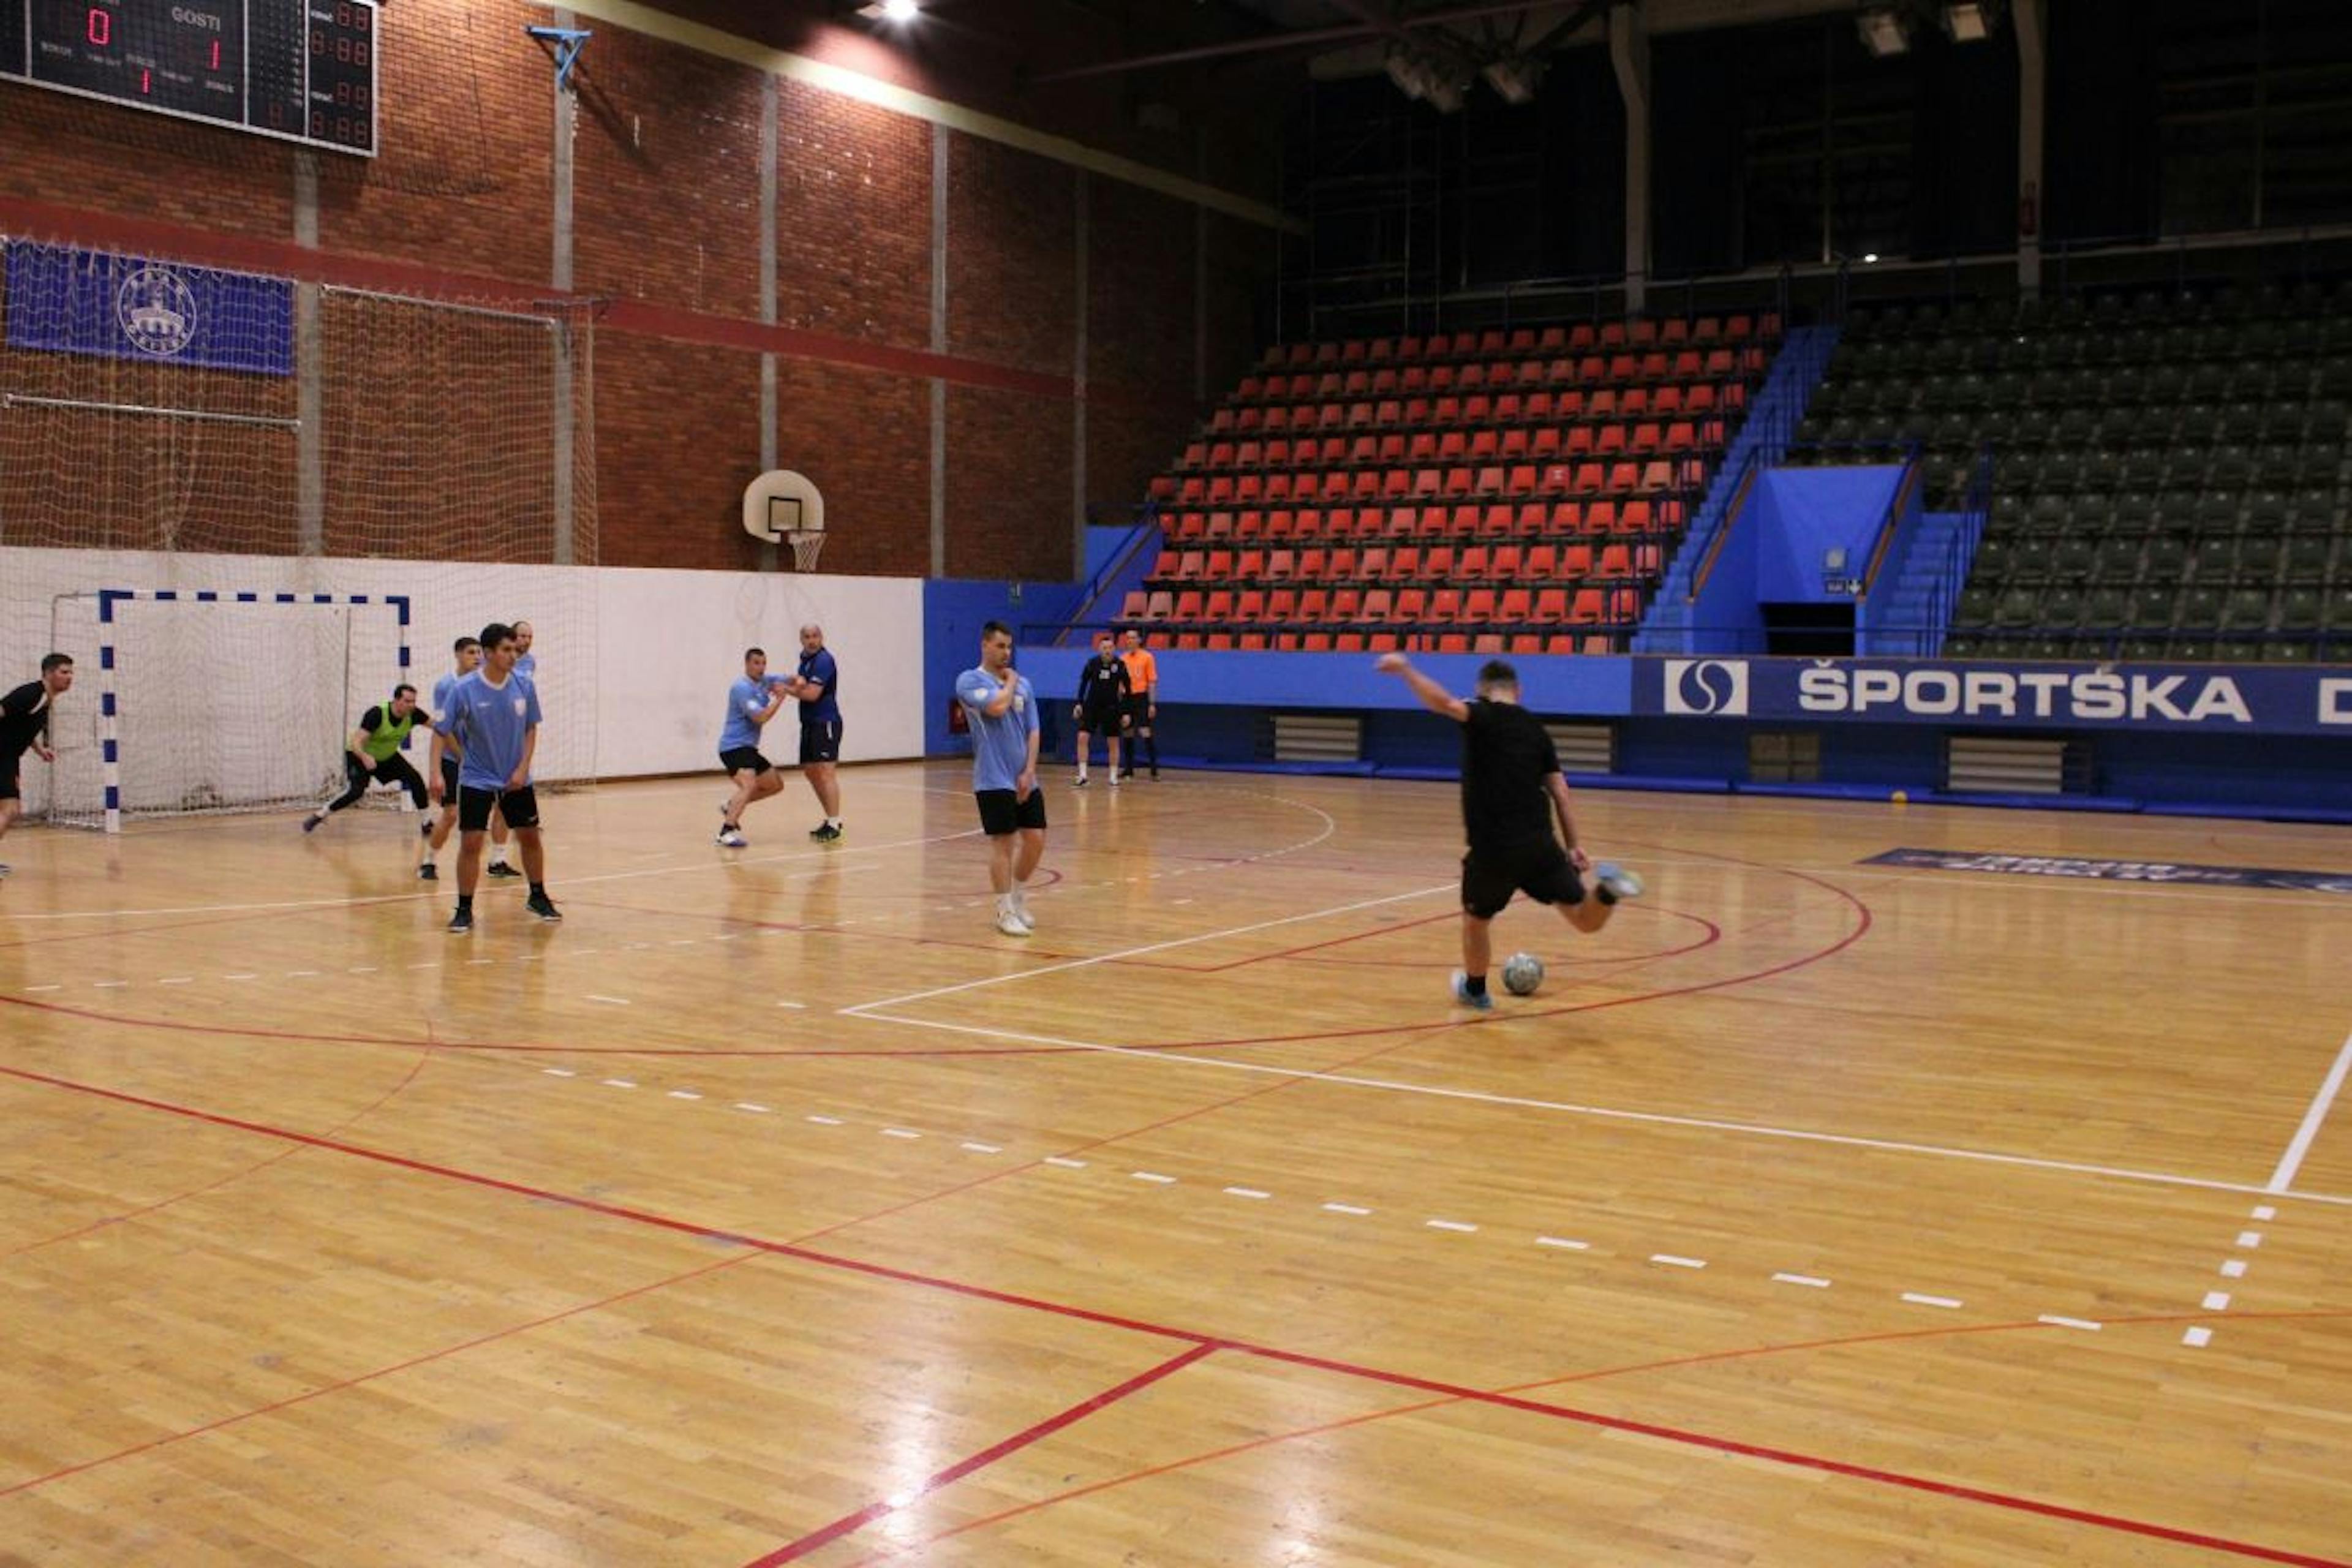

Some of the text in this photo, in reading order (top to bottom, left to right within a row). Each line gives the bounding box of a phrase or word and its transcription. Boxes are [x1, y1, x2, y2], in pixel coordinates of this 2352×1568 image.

[172, 6, 221, 31] GOSTI
[212, 39, 219, 70] 1
[142, 68, 149, 94] 1
